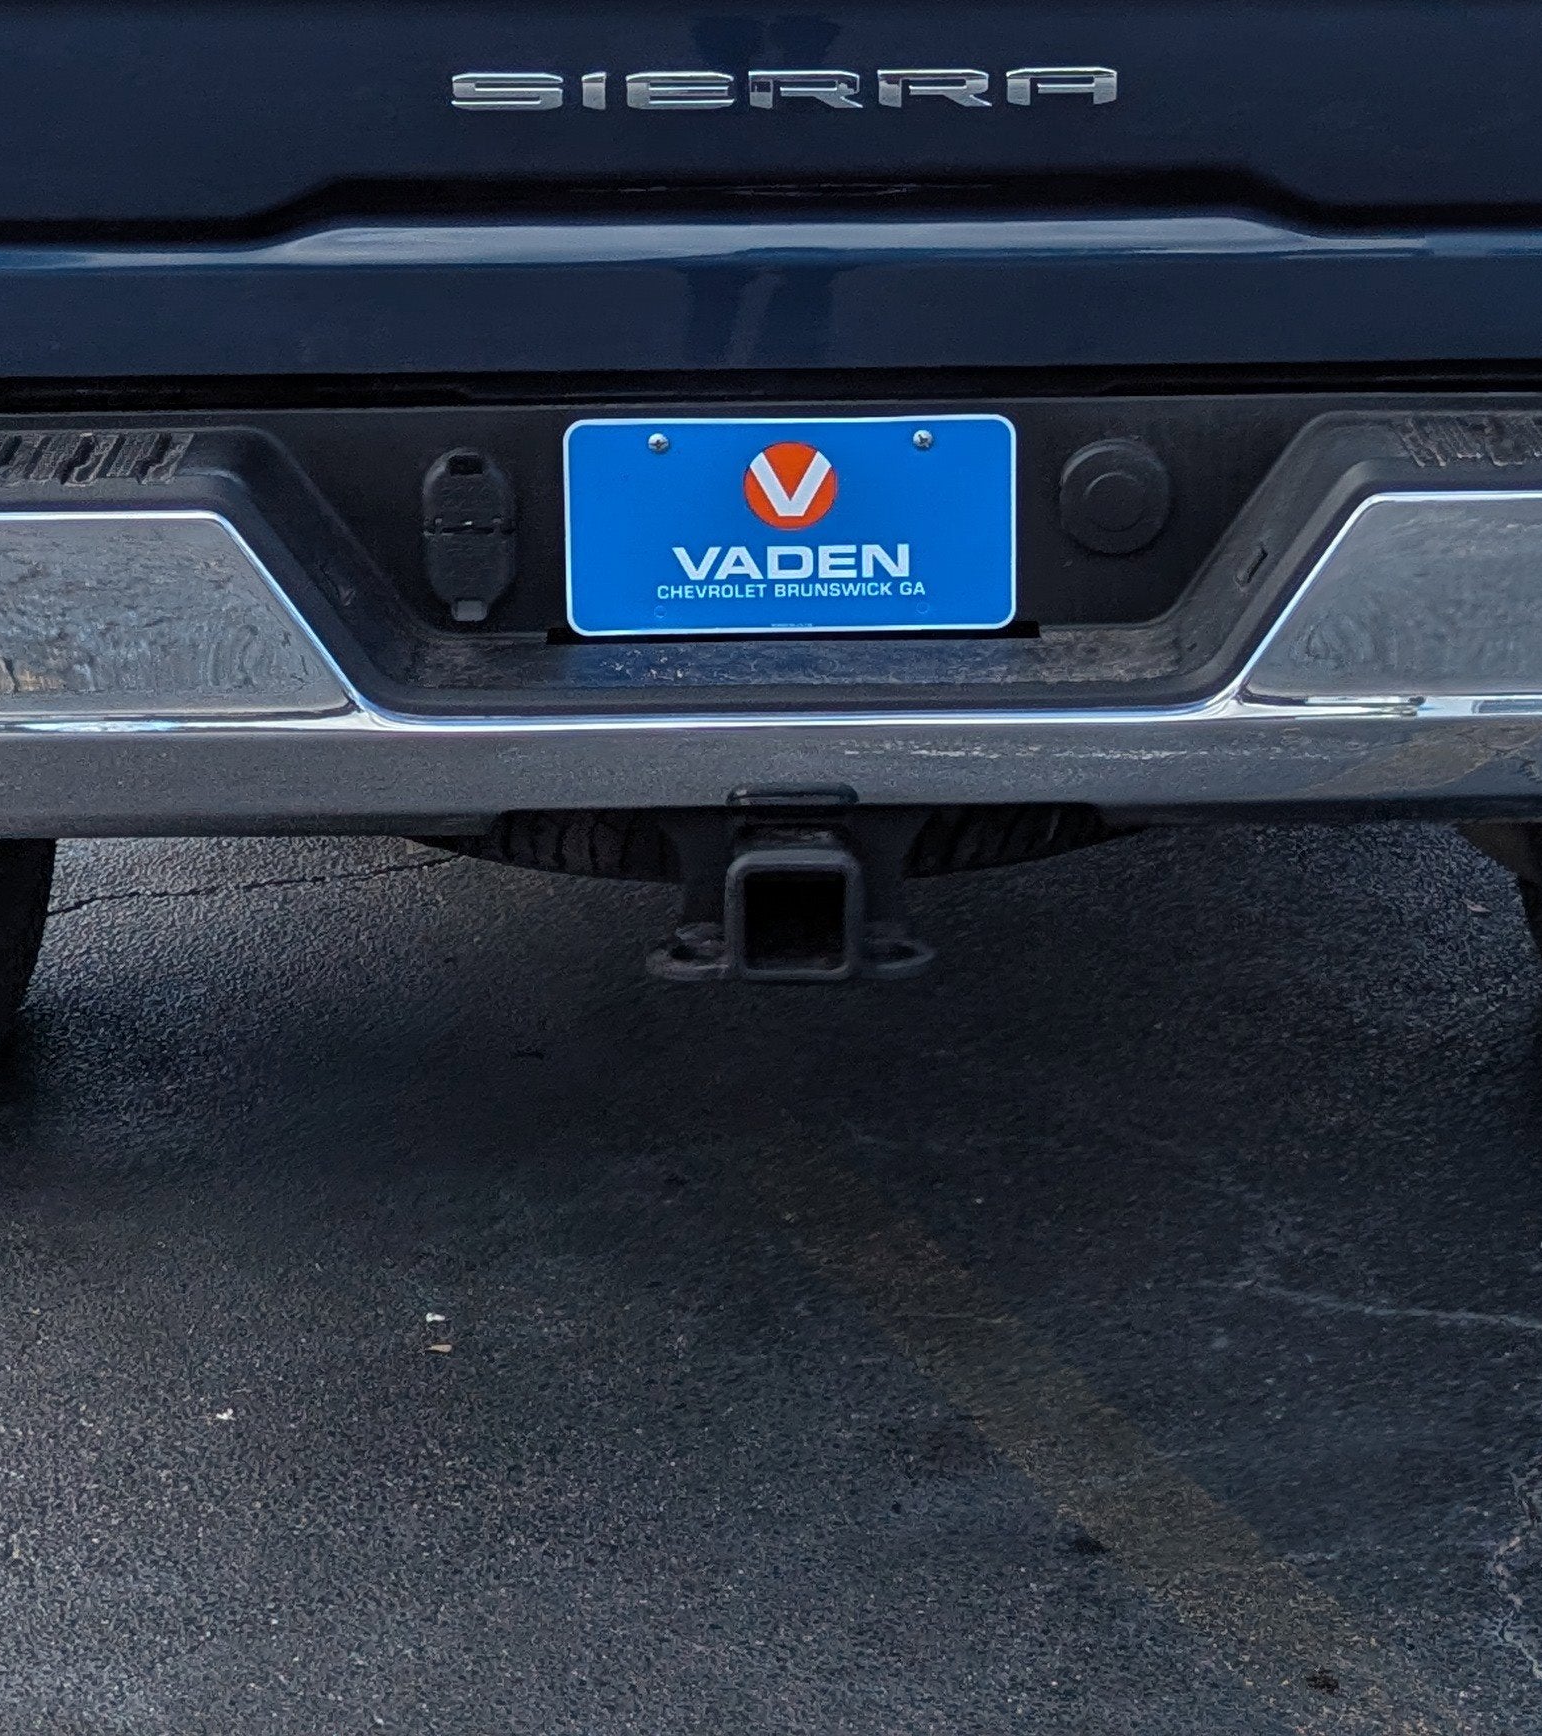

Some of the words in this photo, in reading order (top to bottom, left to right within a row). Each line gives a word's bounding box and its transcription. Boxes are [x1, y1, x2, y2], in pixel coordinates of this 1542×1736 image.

[451, 66, 1119, 111] SIERRA
[749, 450, 833, 518] V
[671, 542, 911, 582] VADEN
[657, 583, 768, 600] CHEVROLET
[774, 581, 893, 598] BRUNSWICK
[899, 580, 927, 596] GA
